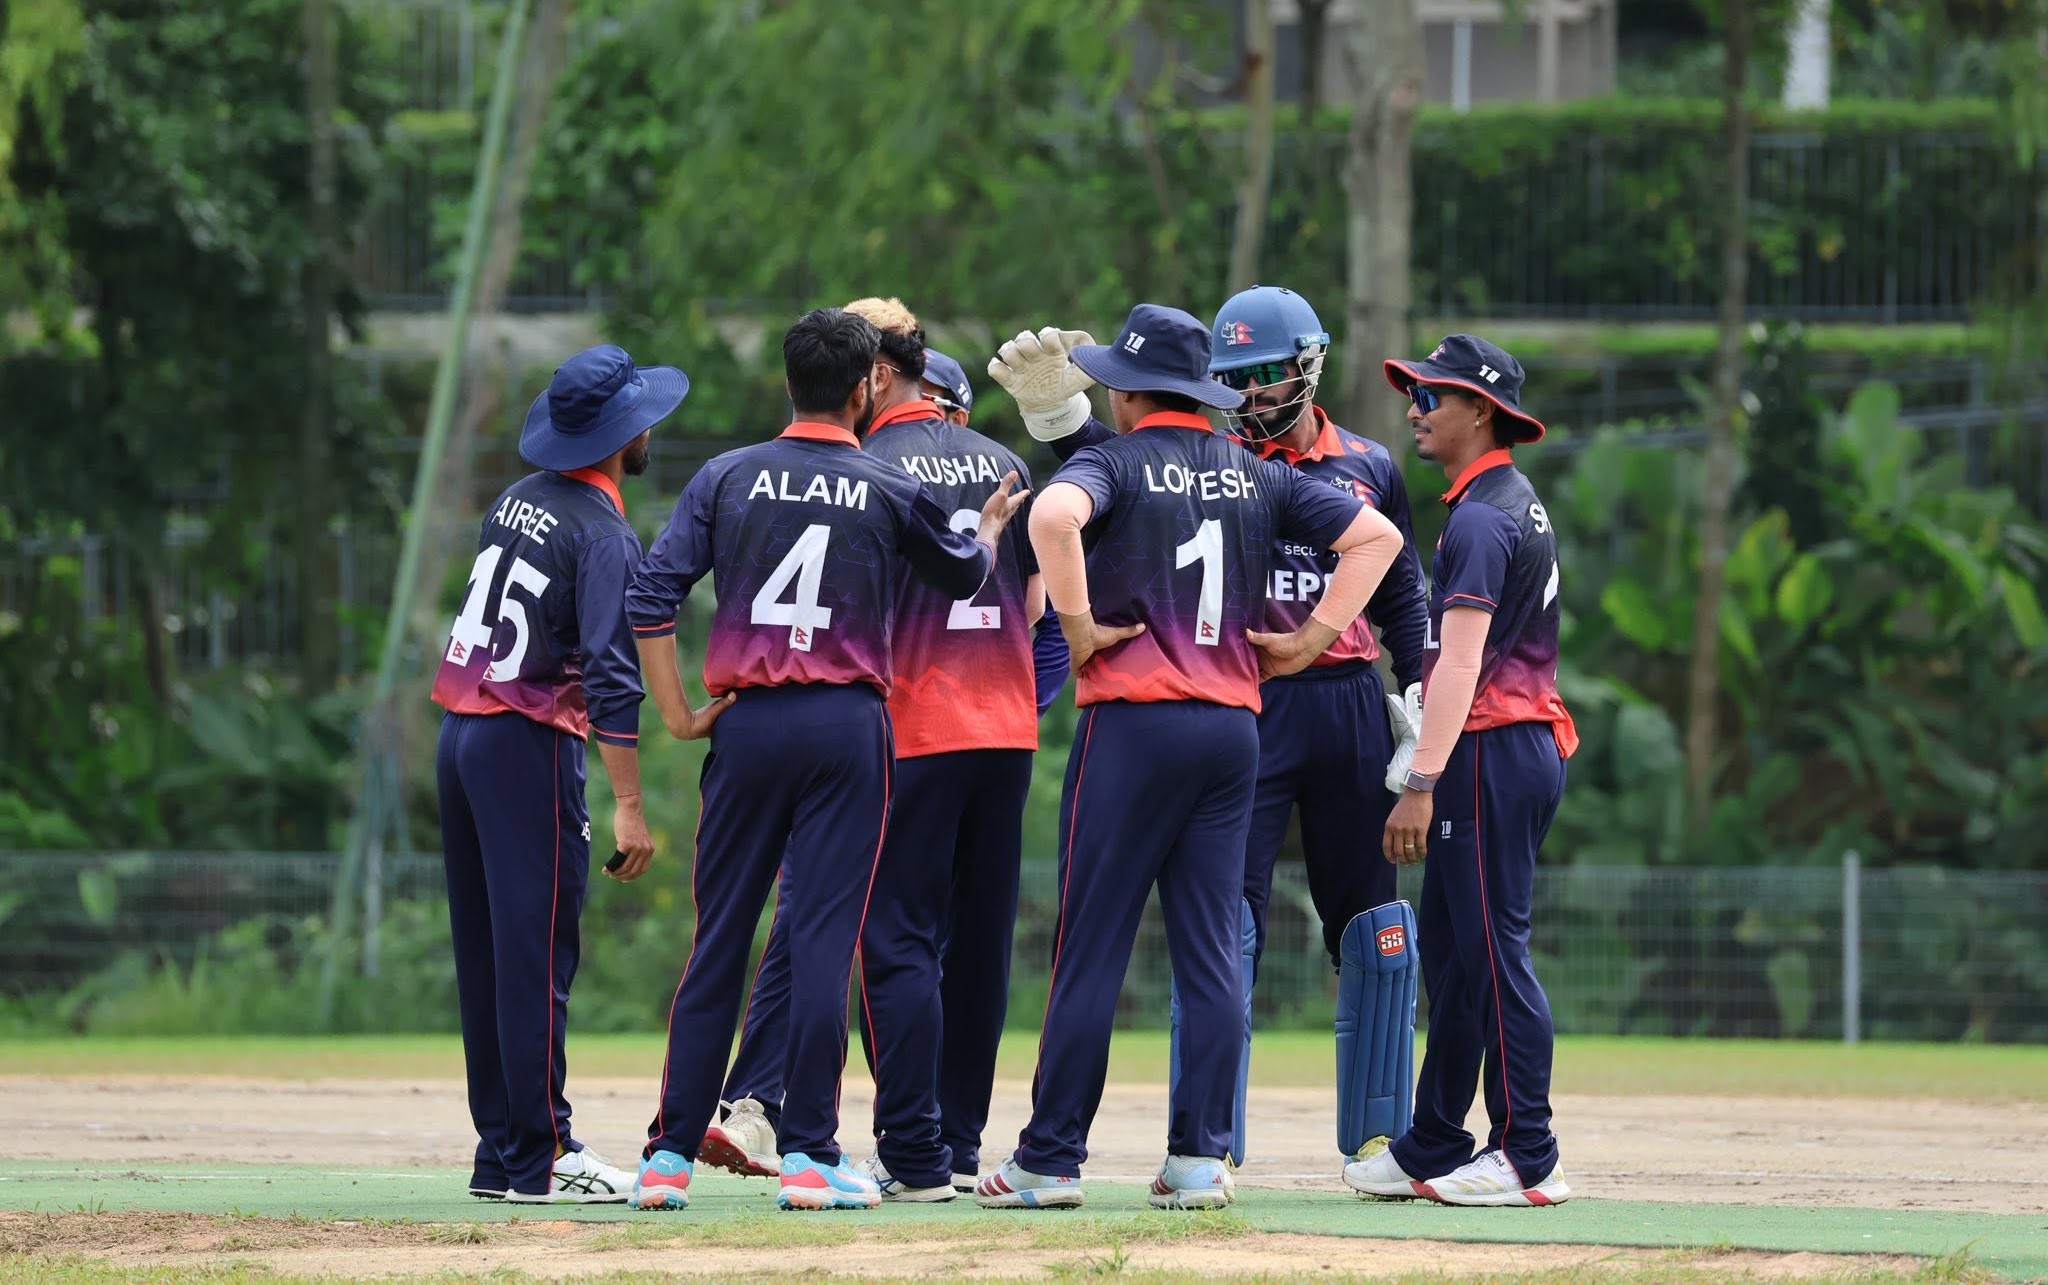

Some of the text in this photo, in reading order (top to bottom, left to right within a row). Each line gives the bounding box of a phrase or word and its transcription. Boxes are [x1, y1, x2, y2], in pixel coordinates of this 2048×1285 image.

[748, 469, 868, 511] ALAM
[1144, 464, 1258, 500] LOKESH
[491, 496, 559, 545] AIREE
[751, 524, 832, 652] 4
[1176, 519, 1223, 646] 1
[446, 544, 551, 682] 45
[1381, 932, 1403, 949] SS
